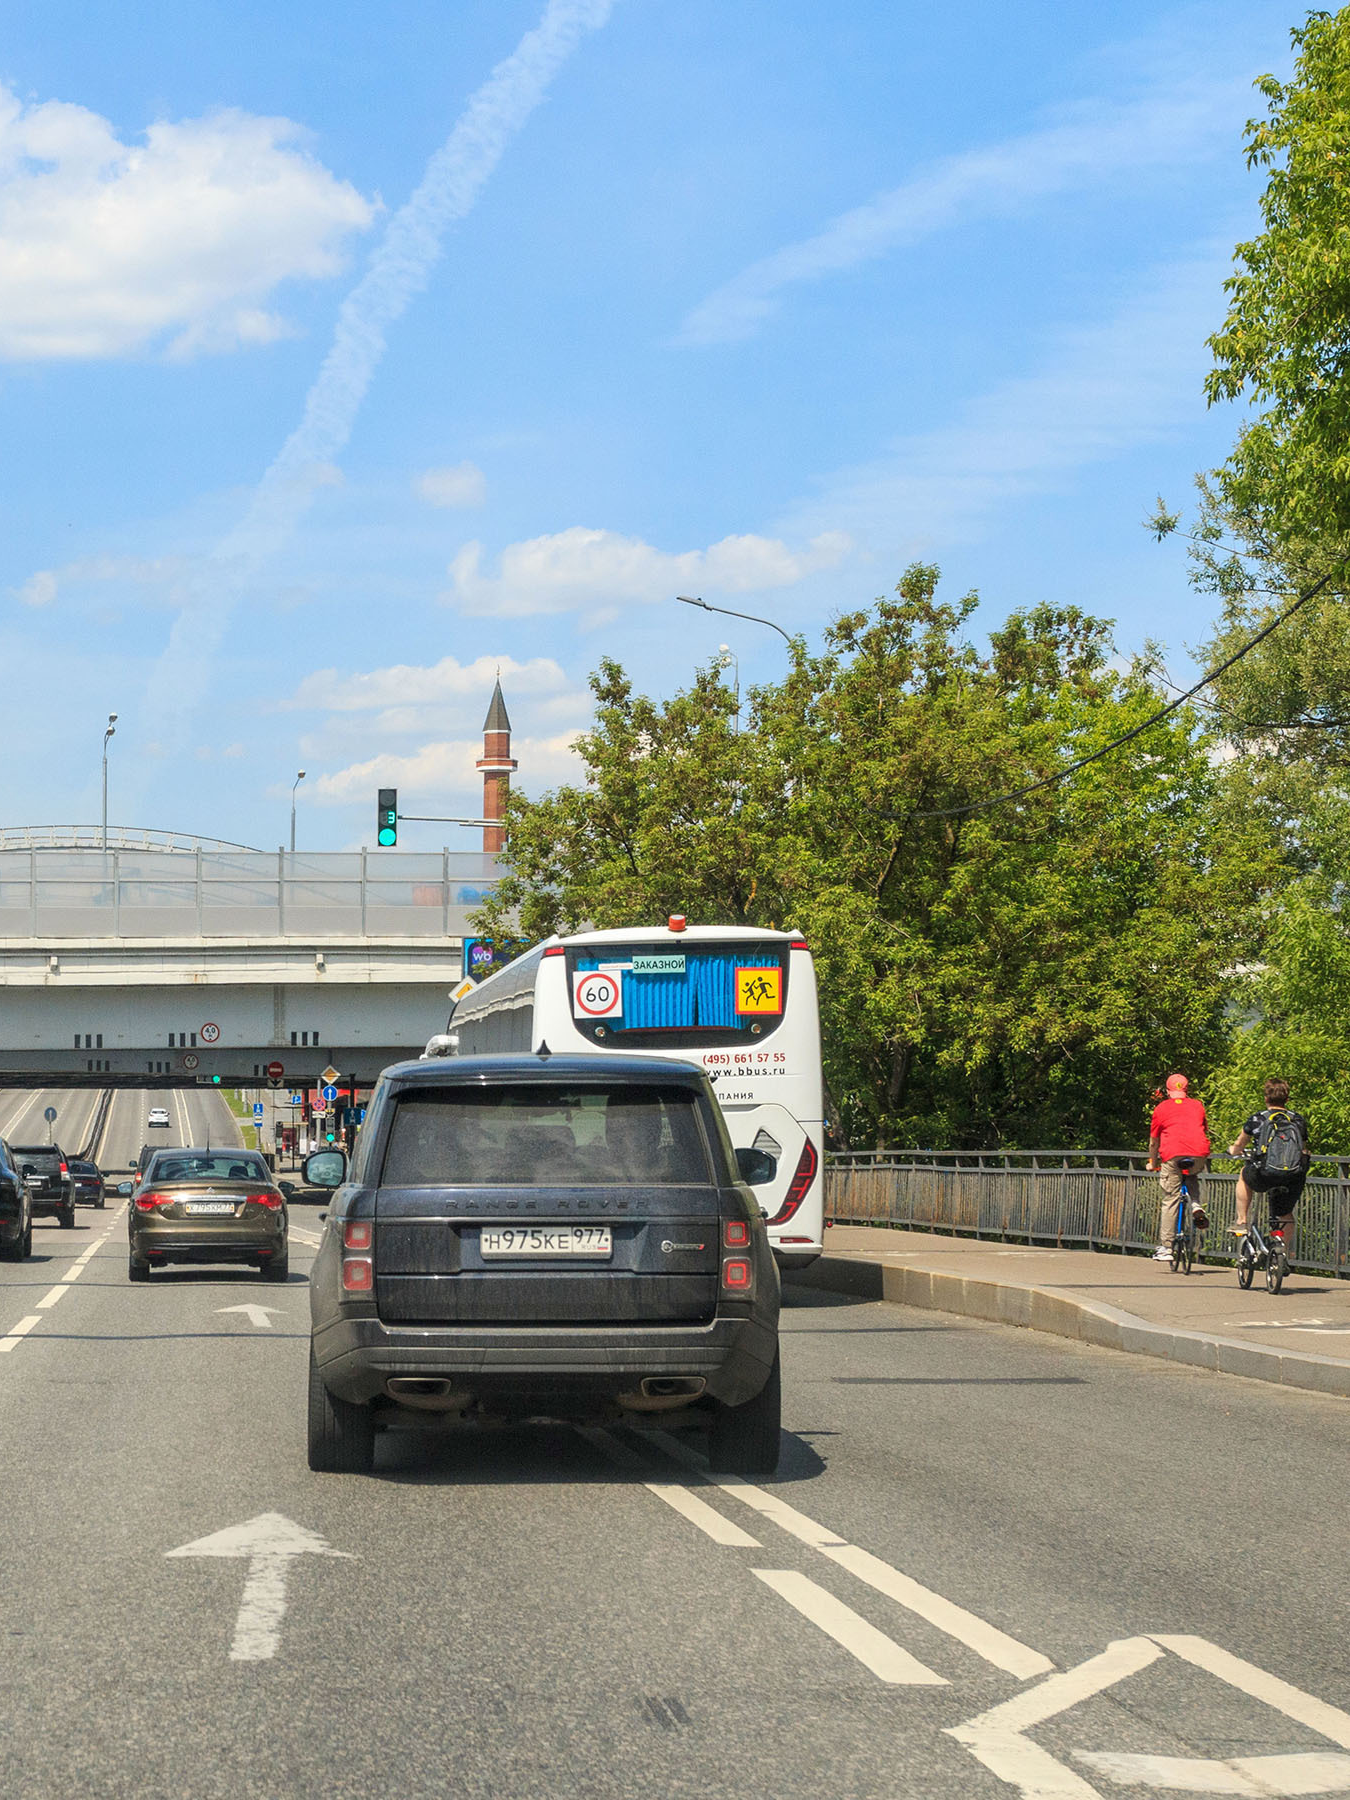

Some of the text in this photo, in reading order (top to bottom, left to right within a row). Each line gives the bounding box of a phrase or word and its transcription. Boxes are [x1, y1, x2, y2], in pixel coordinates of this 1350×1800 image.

[388, 811, 395, 824] 3
[473, 950, 492, 961] wb
[633, 957, 685, 969] ЗАКАЗНОЙ
[586, 986, 610, 1003] 60
[702, 1052, 786, 1066] (495) 661 57 55
[716, 1092, 754, 1100] ПАНИЯ
[445, 1199, 650, 1209] RANGE ROVER
[574, 1228, 605, 1244] 977
